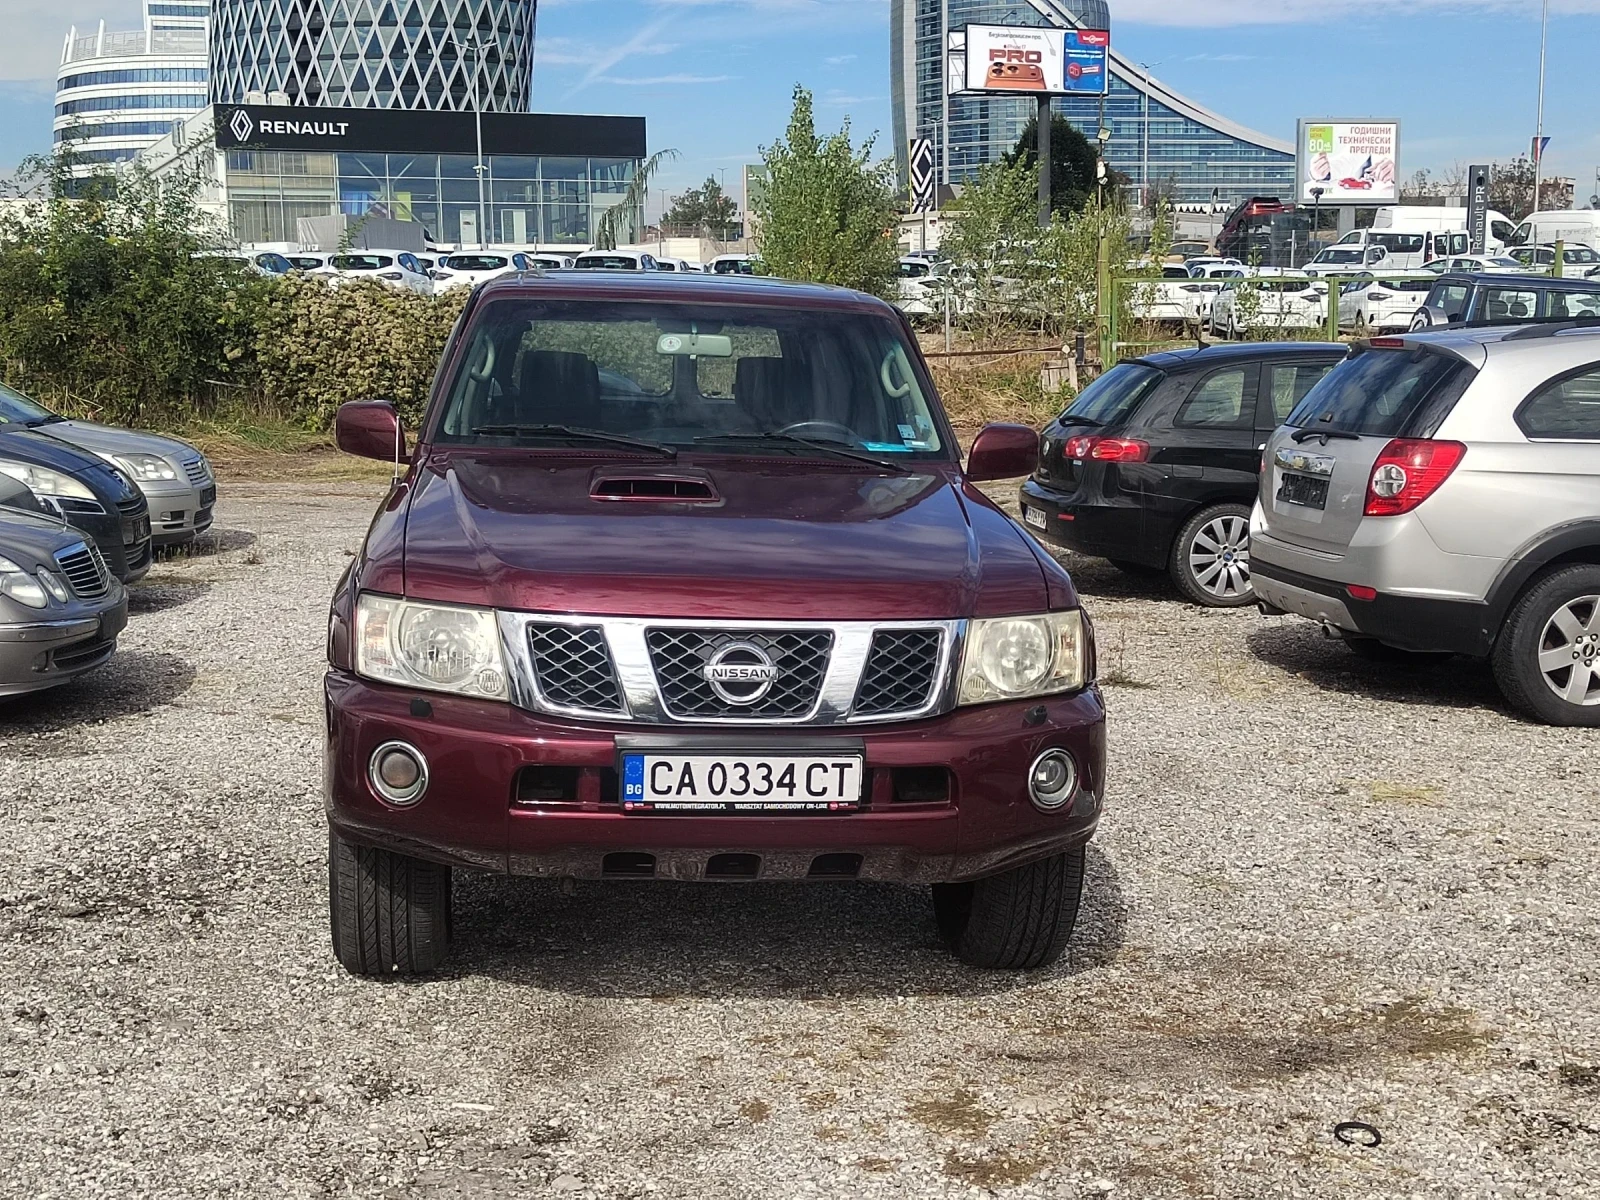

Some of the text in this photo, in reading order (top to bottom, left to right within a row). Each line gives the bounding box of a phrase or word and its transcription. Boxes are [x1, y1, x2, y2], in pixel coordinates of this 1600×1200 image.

[989, 48, 1042, 63] PRO
[259, 120, 349, 136] RENAULT
[1350, 126, 1391, 135] ГОДИШНИ
[1309, 139, 1324, 152] 80
[1338, 136, 1391, 144] ТЕХНИЧЕСКИ
[1349, 146, 1391, 154] ПРЕГЛЕДИ
[1472, 206, 1484, 253] Renault
[712, 668, 771, 678] NISSAN
[650, 761, 853, 797] CA 0334 CT
[626, 784, 642, 795] BG
